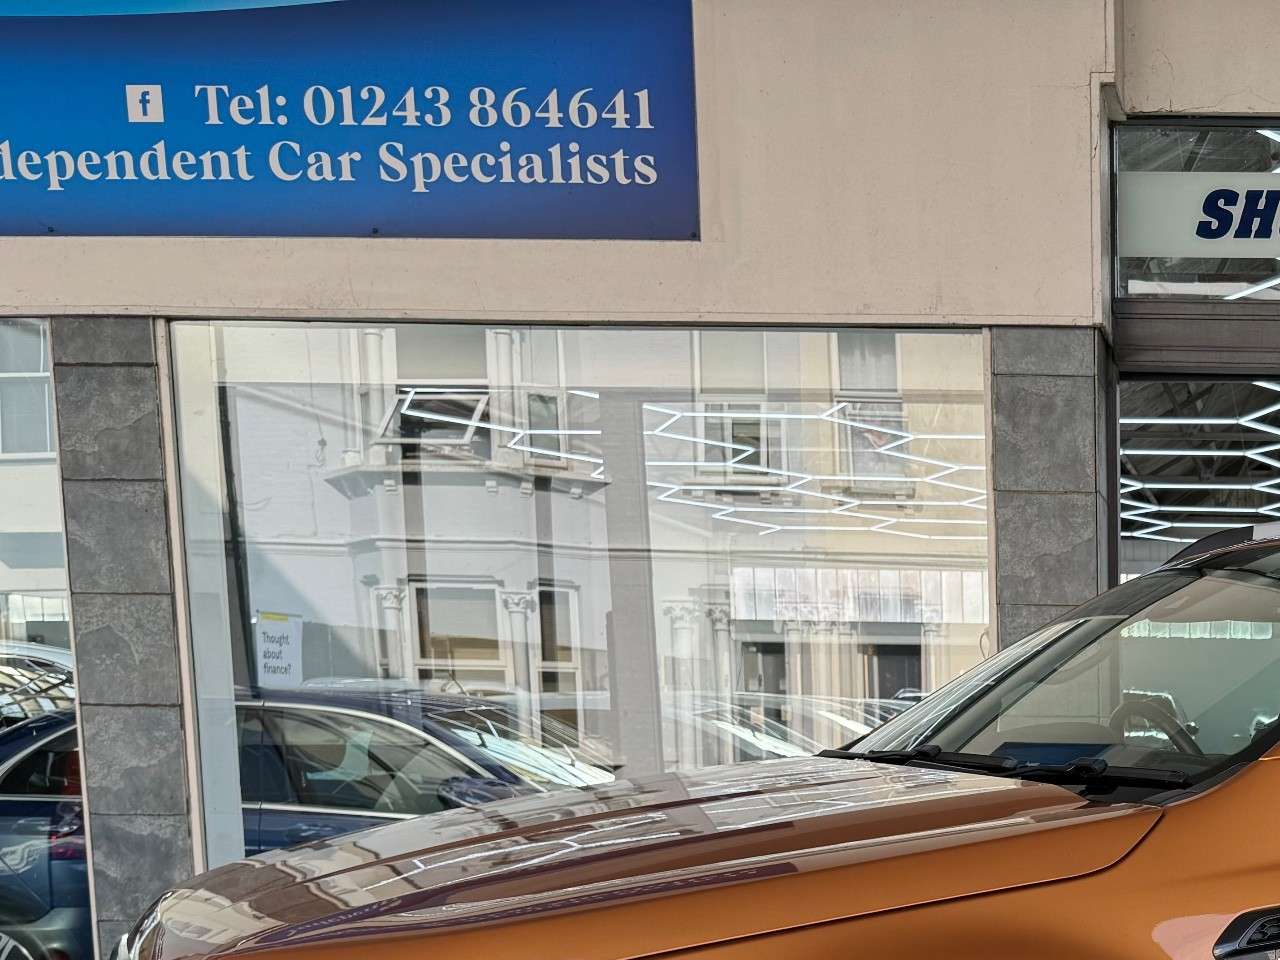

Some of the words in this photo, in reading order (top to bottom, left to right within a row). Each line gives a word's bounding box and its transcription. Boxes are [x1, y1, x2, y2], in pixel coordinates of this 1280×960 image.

[195, 85, 288, 125] Tel:
[304, 86, 451, 127] 01243
[470, 87, 655, 128] 864641
[269, 141, 362, 181] Car
[379, 142, 658, 192] Specialists
[262, 631, 290, 647] Thought
[263, 648, 283, 660] about
[263, 662, 292, 675] finance?
